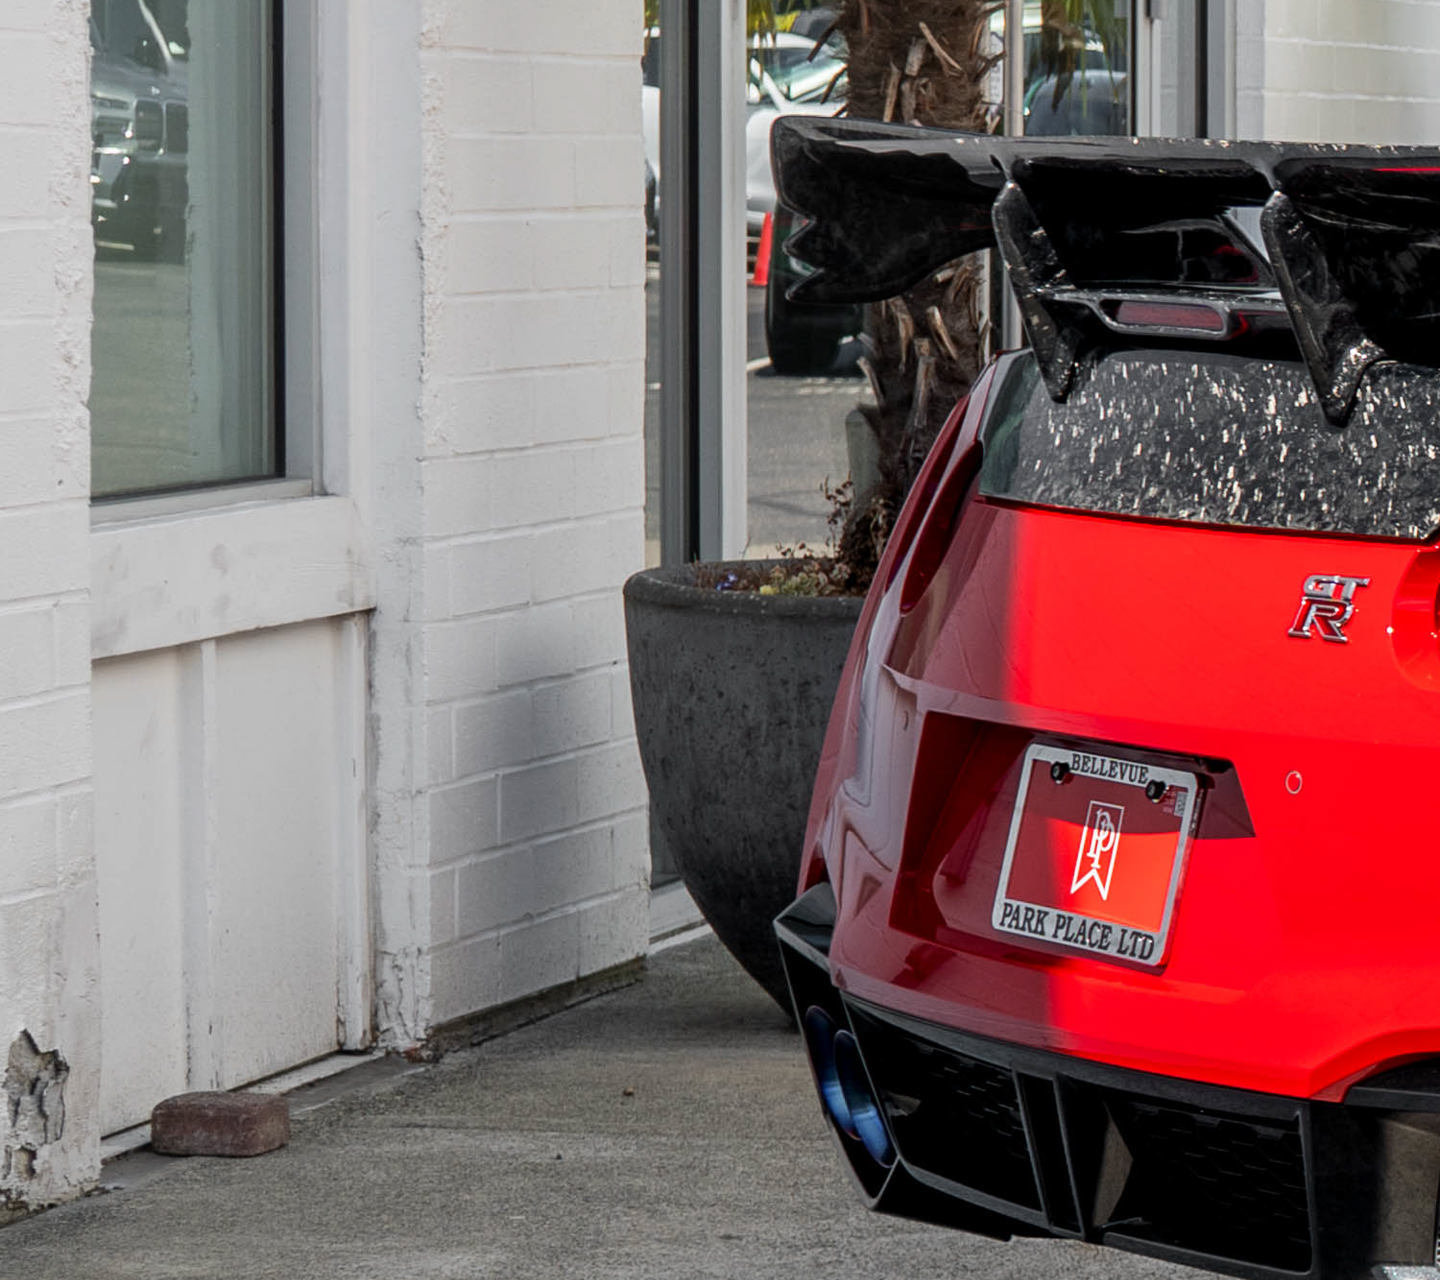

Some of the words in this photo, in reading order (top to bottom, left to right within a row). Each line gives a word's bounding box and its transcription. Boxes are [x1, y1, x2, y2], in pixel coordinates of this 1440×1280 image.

[1070, 752, 1149, 785] BELLEVUE
[998, 902, 1050, 937] PARK
[1052, 913, 1113, 951] PLACE
[1116, 928, 1155, 961] LTD
